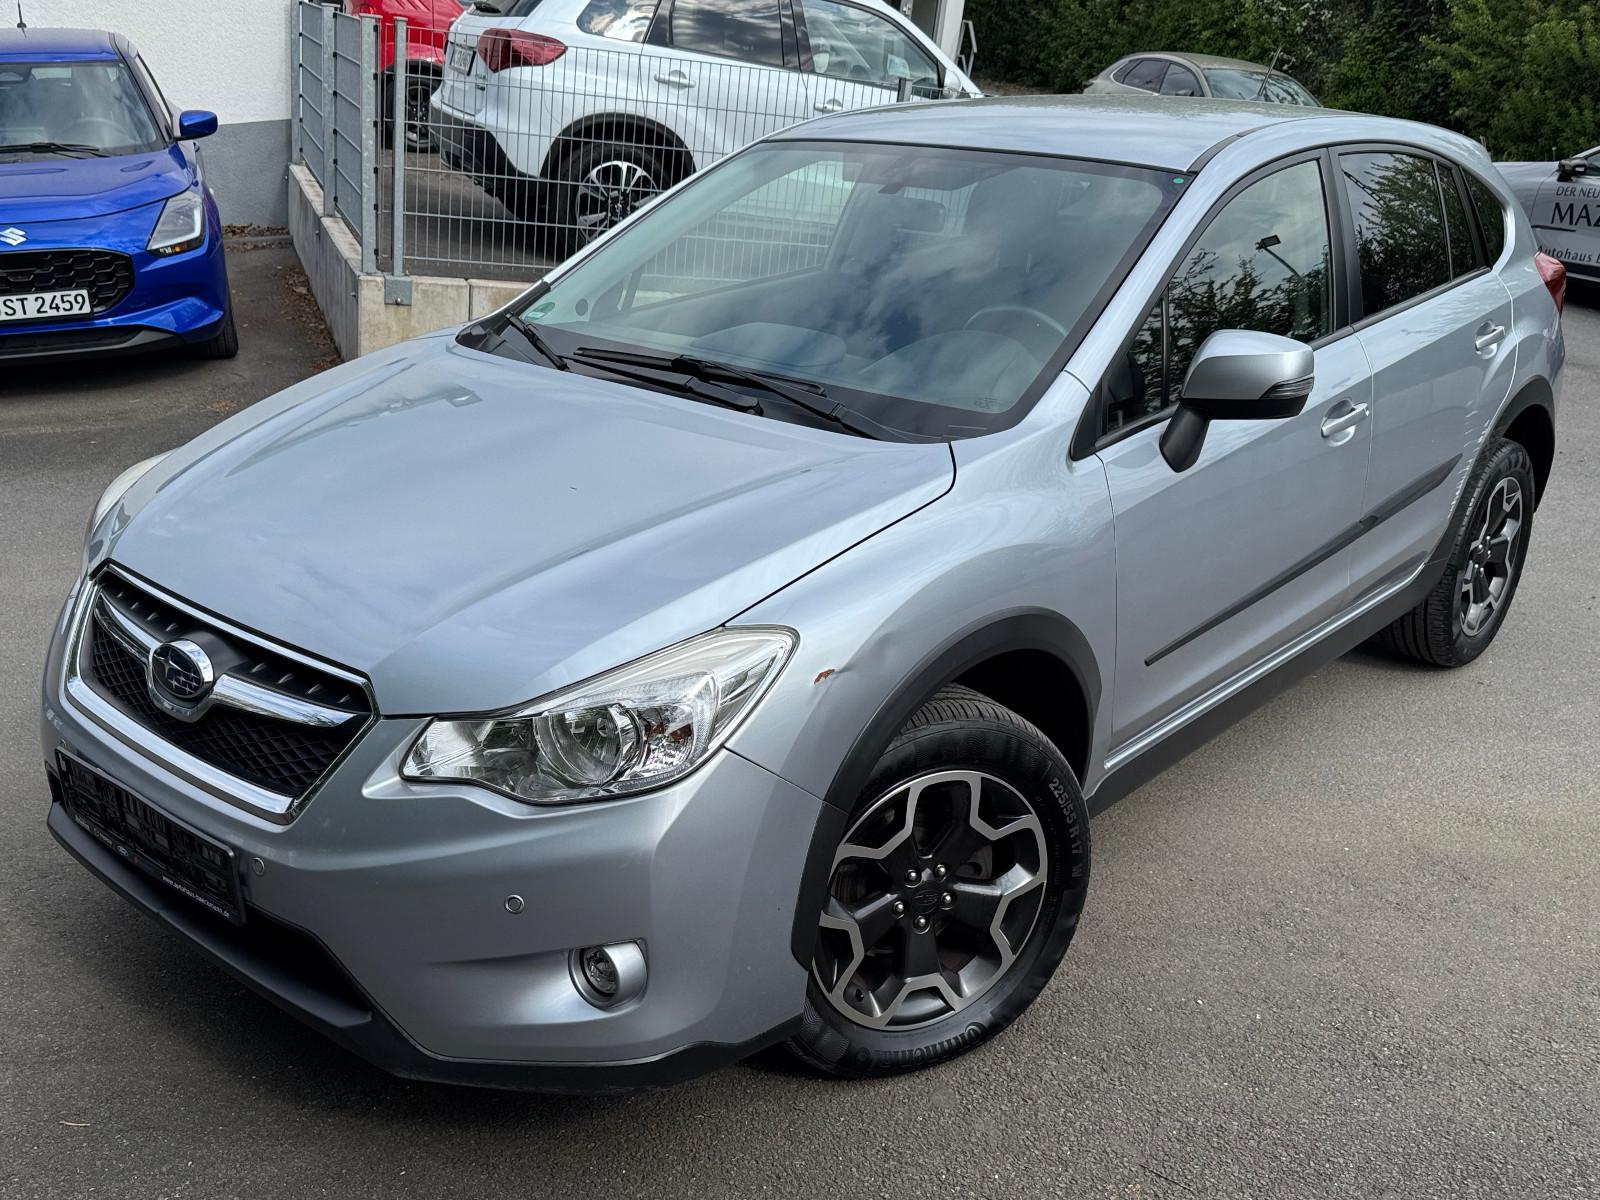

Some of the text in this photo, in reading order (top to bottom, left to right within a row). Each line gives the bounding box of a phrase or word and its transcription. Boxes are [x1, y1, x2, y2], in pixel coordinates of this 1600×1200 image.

[1556, 186, 1576, 197] DER
[34, 293, 86, 314] 2459
[1048, 778, 1077, 825] 225/55
